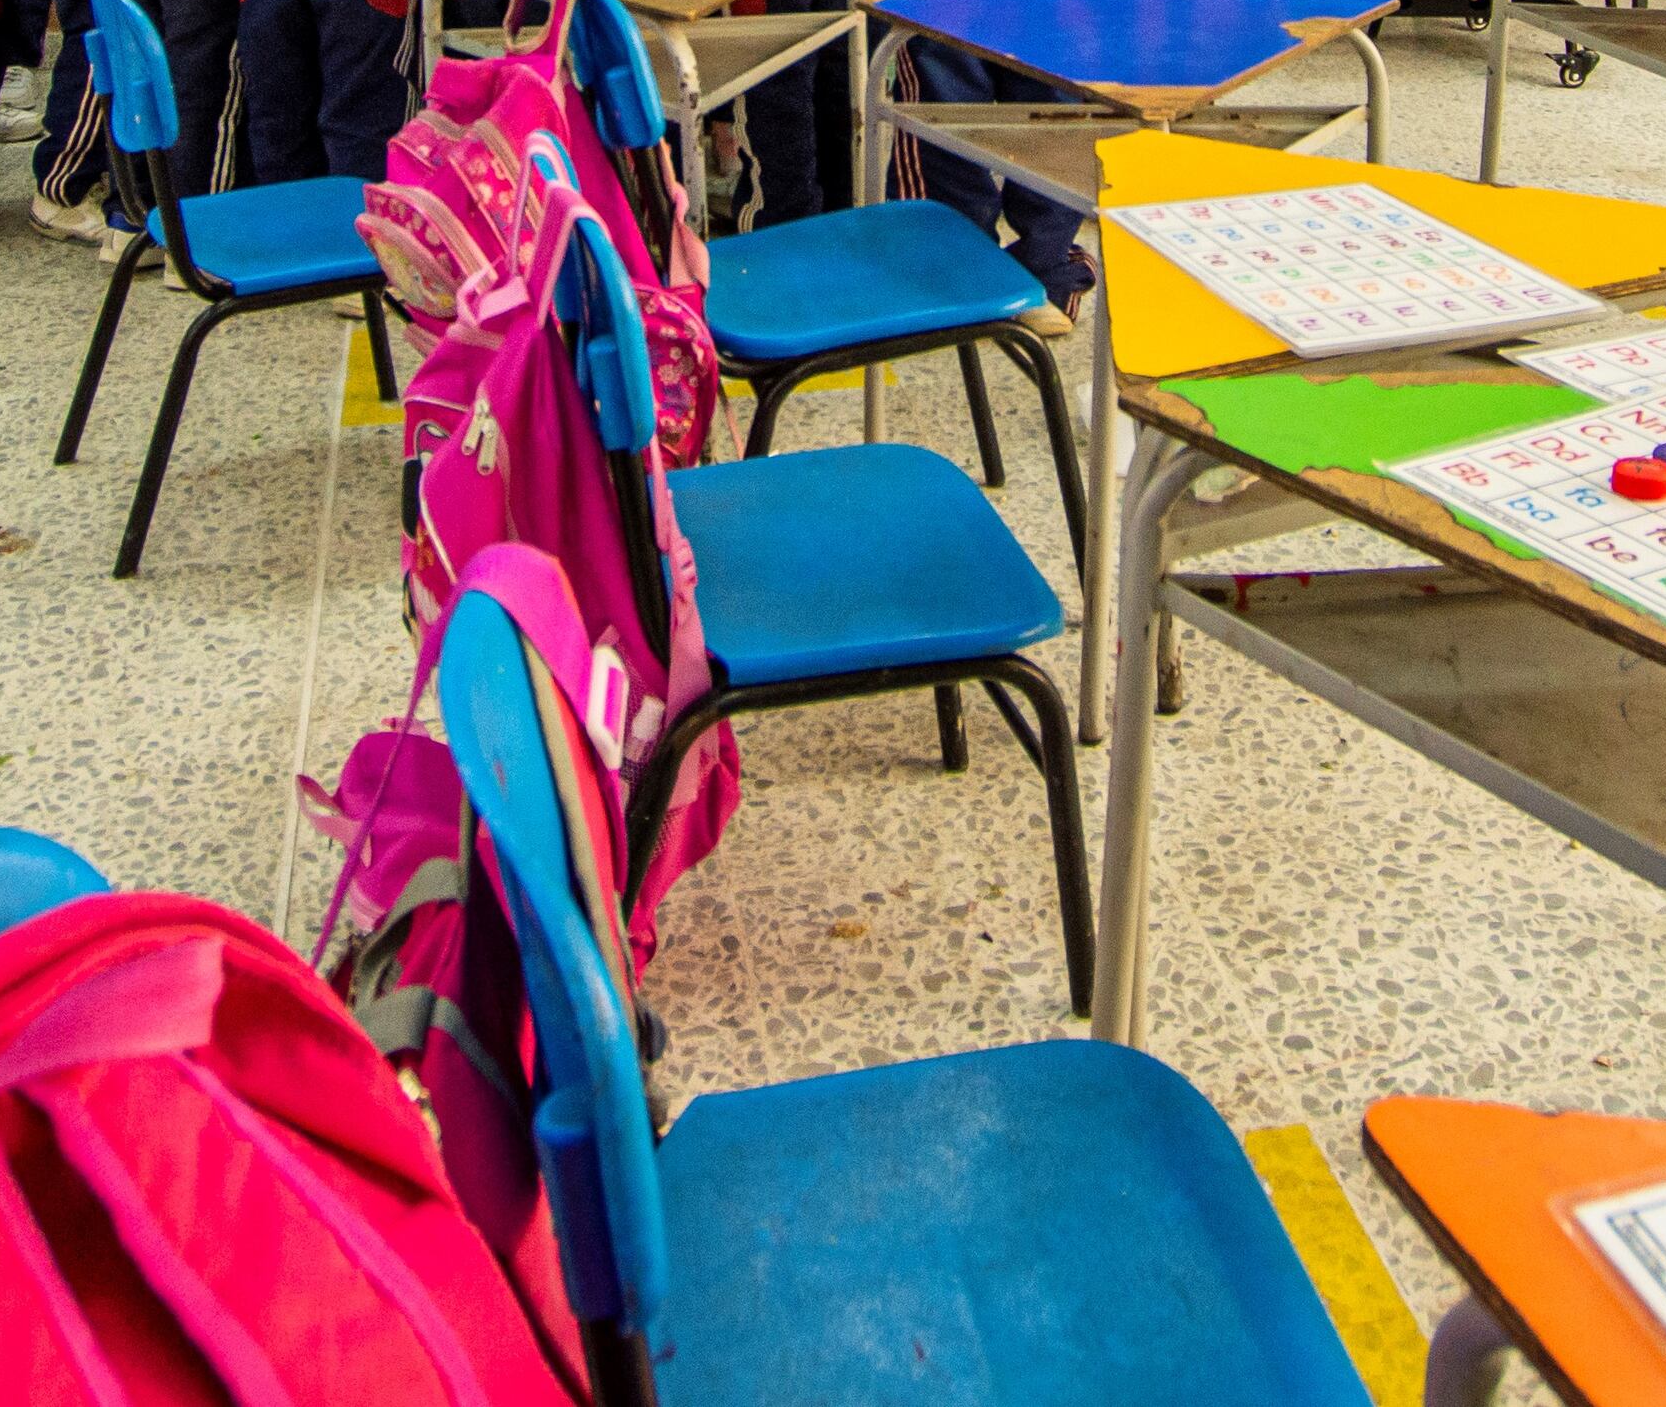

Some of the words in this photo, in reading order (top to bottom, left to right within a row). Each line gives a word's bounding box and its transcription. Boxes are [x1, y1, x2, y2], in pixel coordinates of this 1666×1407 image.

[1580, 424, 1622, 444] Cc
[1442, 462, 1490, 488] Bb
[1506, 497, 1559, 523] ba
[1585, 536, 1638, 564] be
